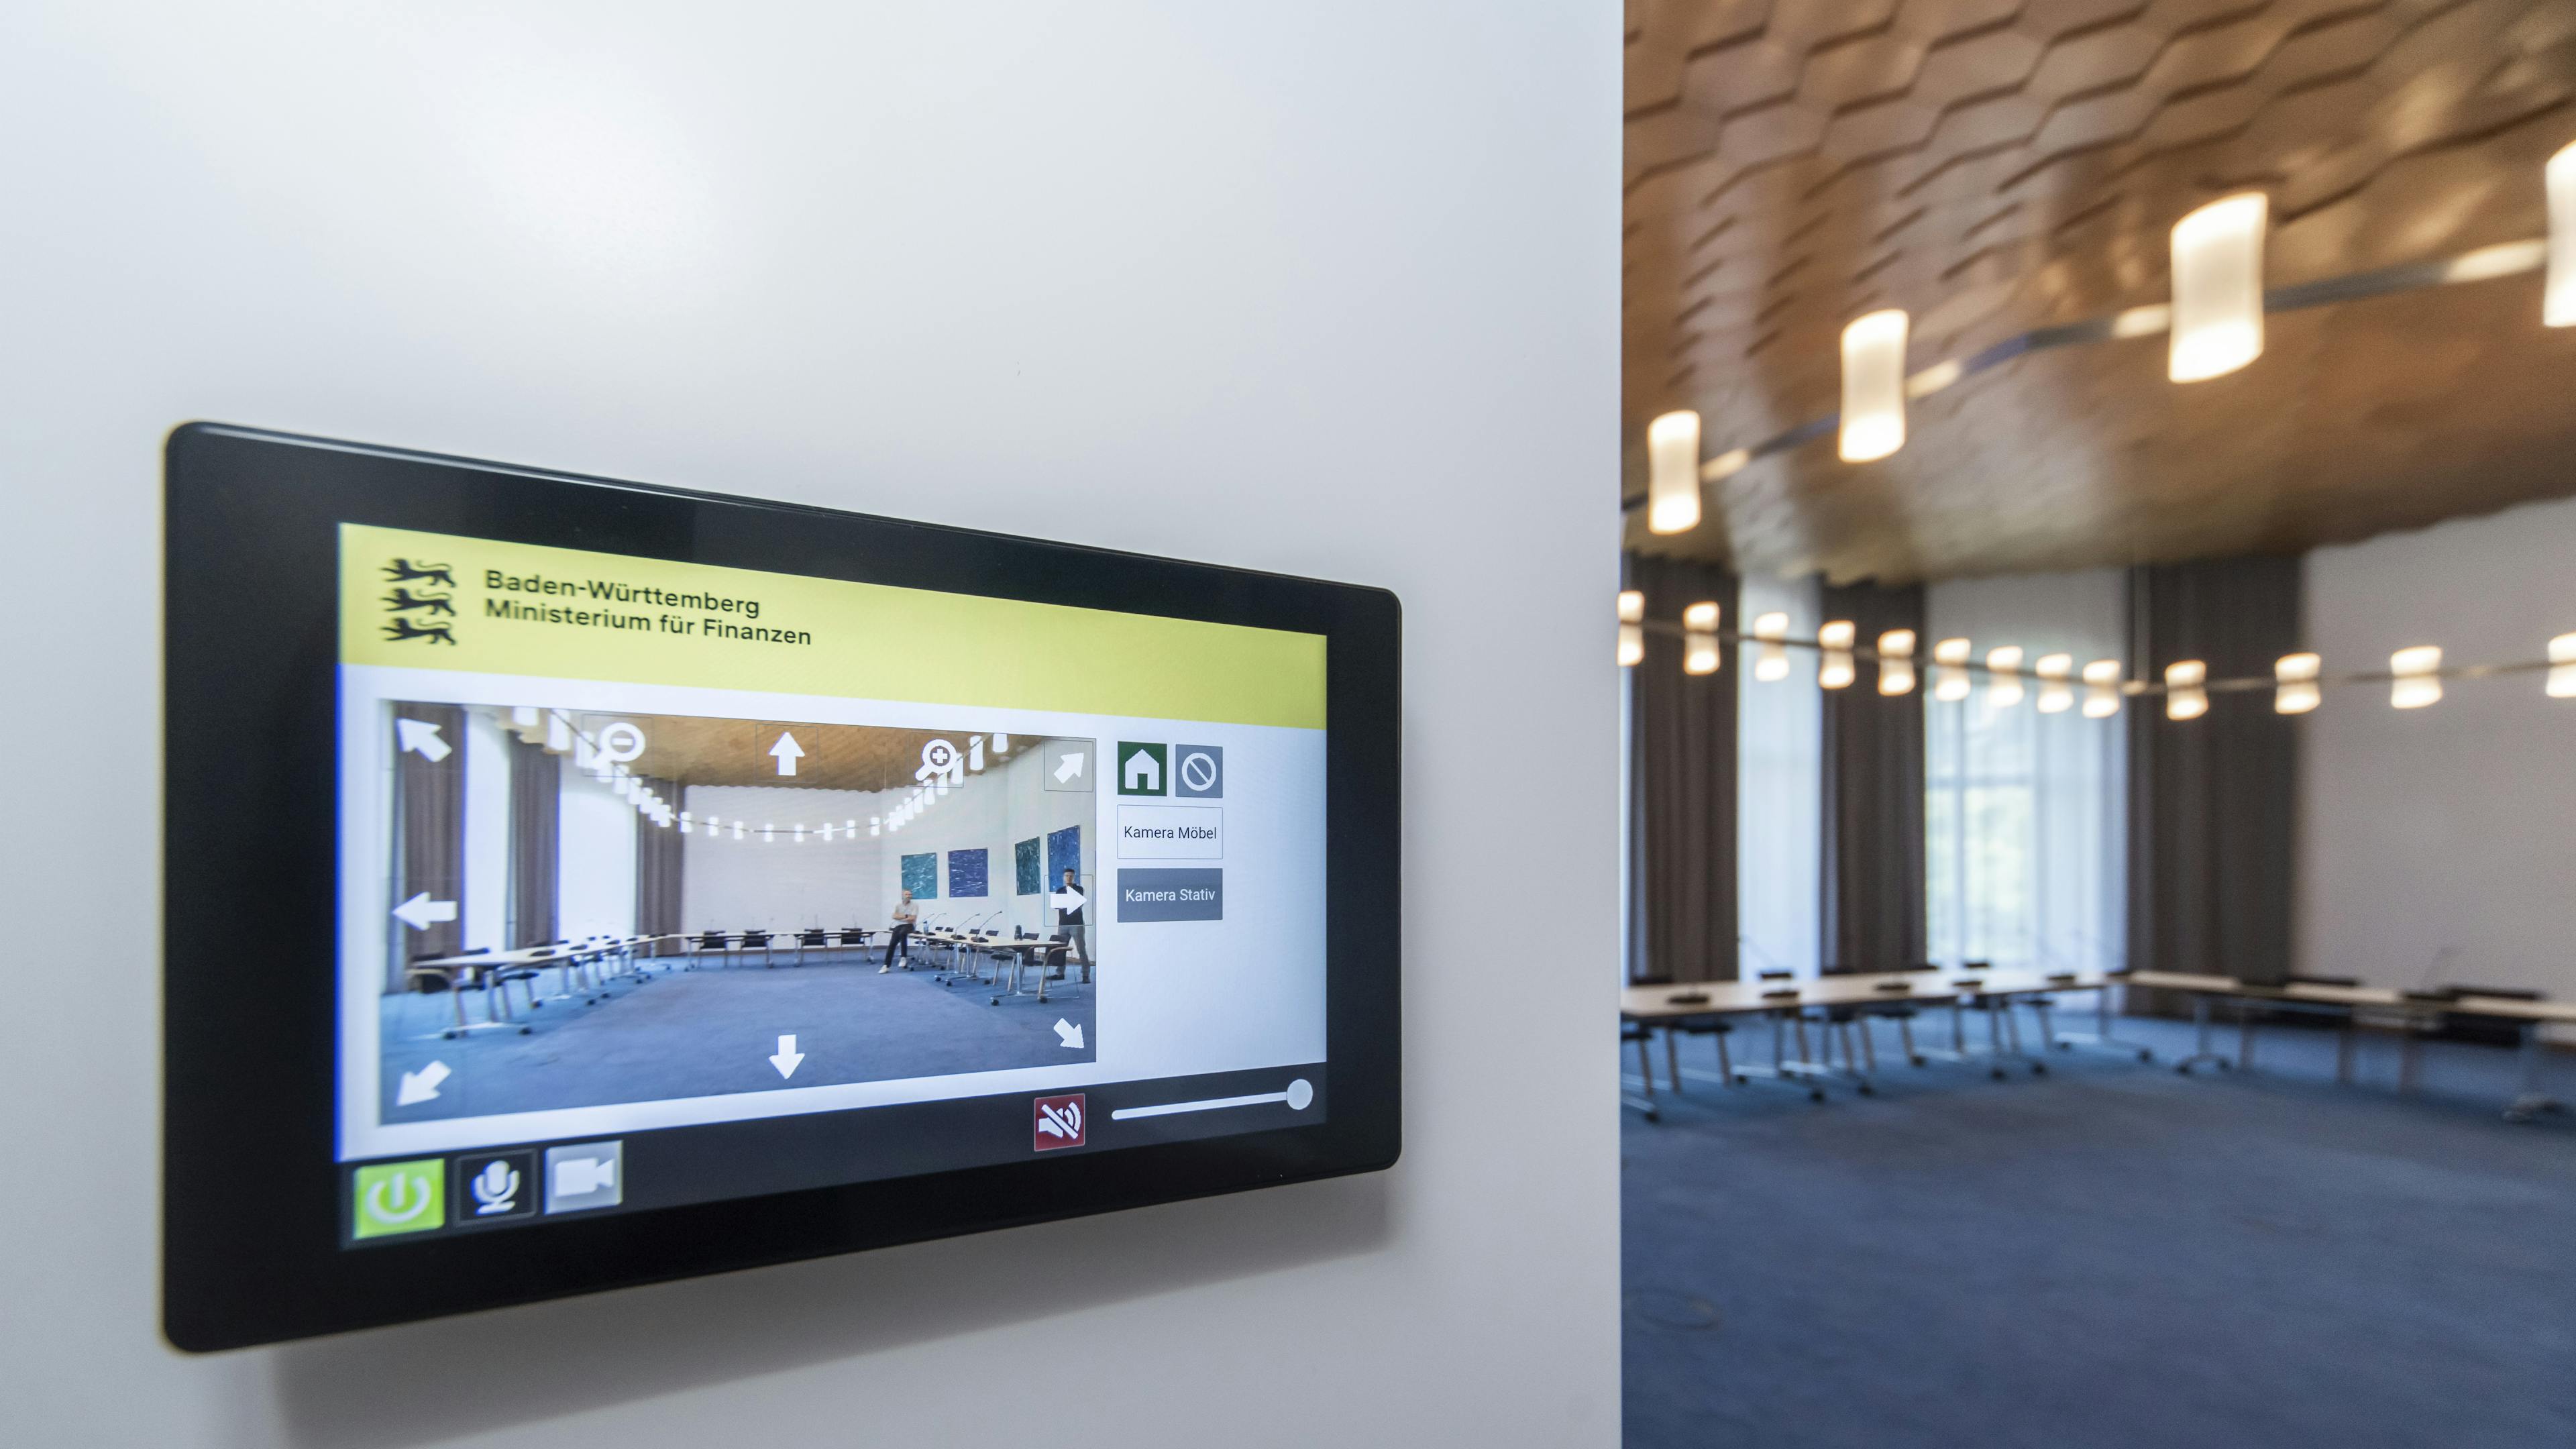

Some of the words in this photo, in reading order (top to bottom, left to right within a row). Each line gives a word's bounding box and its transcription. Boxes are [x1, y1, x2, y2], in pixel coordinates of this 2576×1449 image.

[485, 570, 760, 618] Baden-Württemberg
[485, 598, 651, 632] Ministerium
[659, 614, 695, 635] für
[704, 619, 812, 645] Finanzen
[1124, 826, 1174, 839] Kamera
[1178, 826, 1217, 839] Möbel
[1126, 889, 1176, 902] Kamera
[1179, 888, 1216, 901] Stativ
